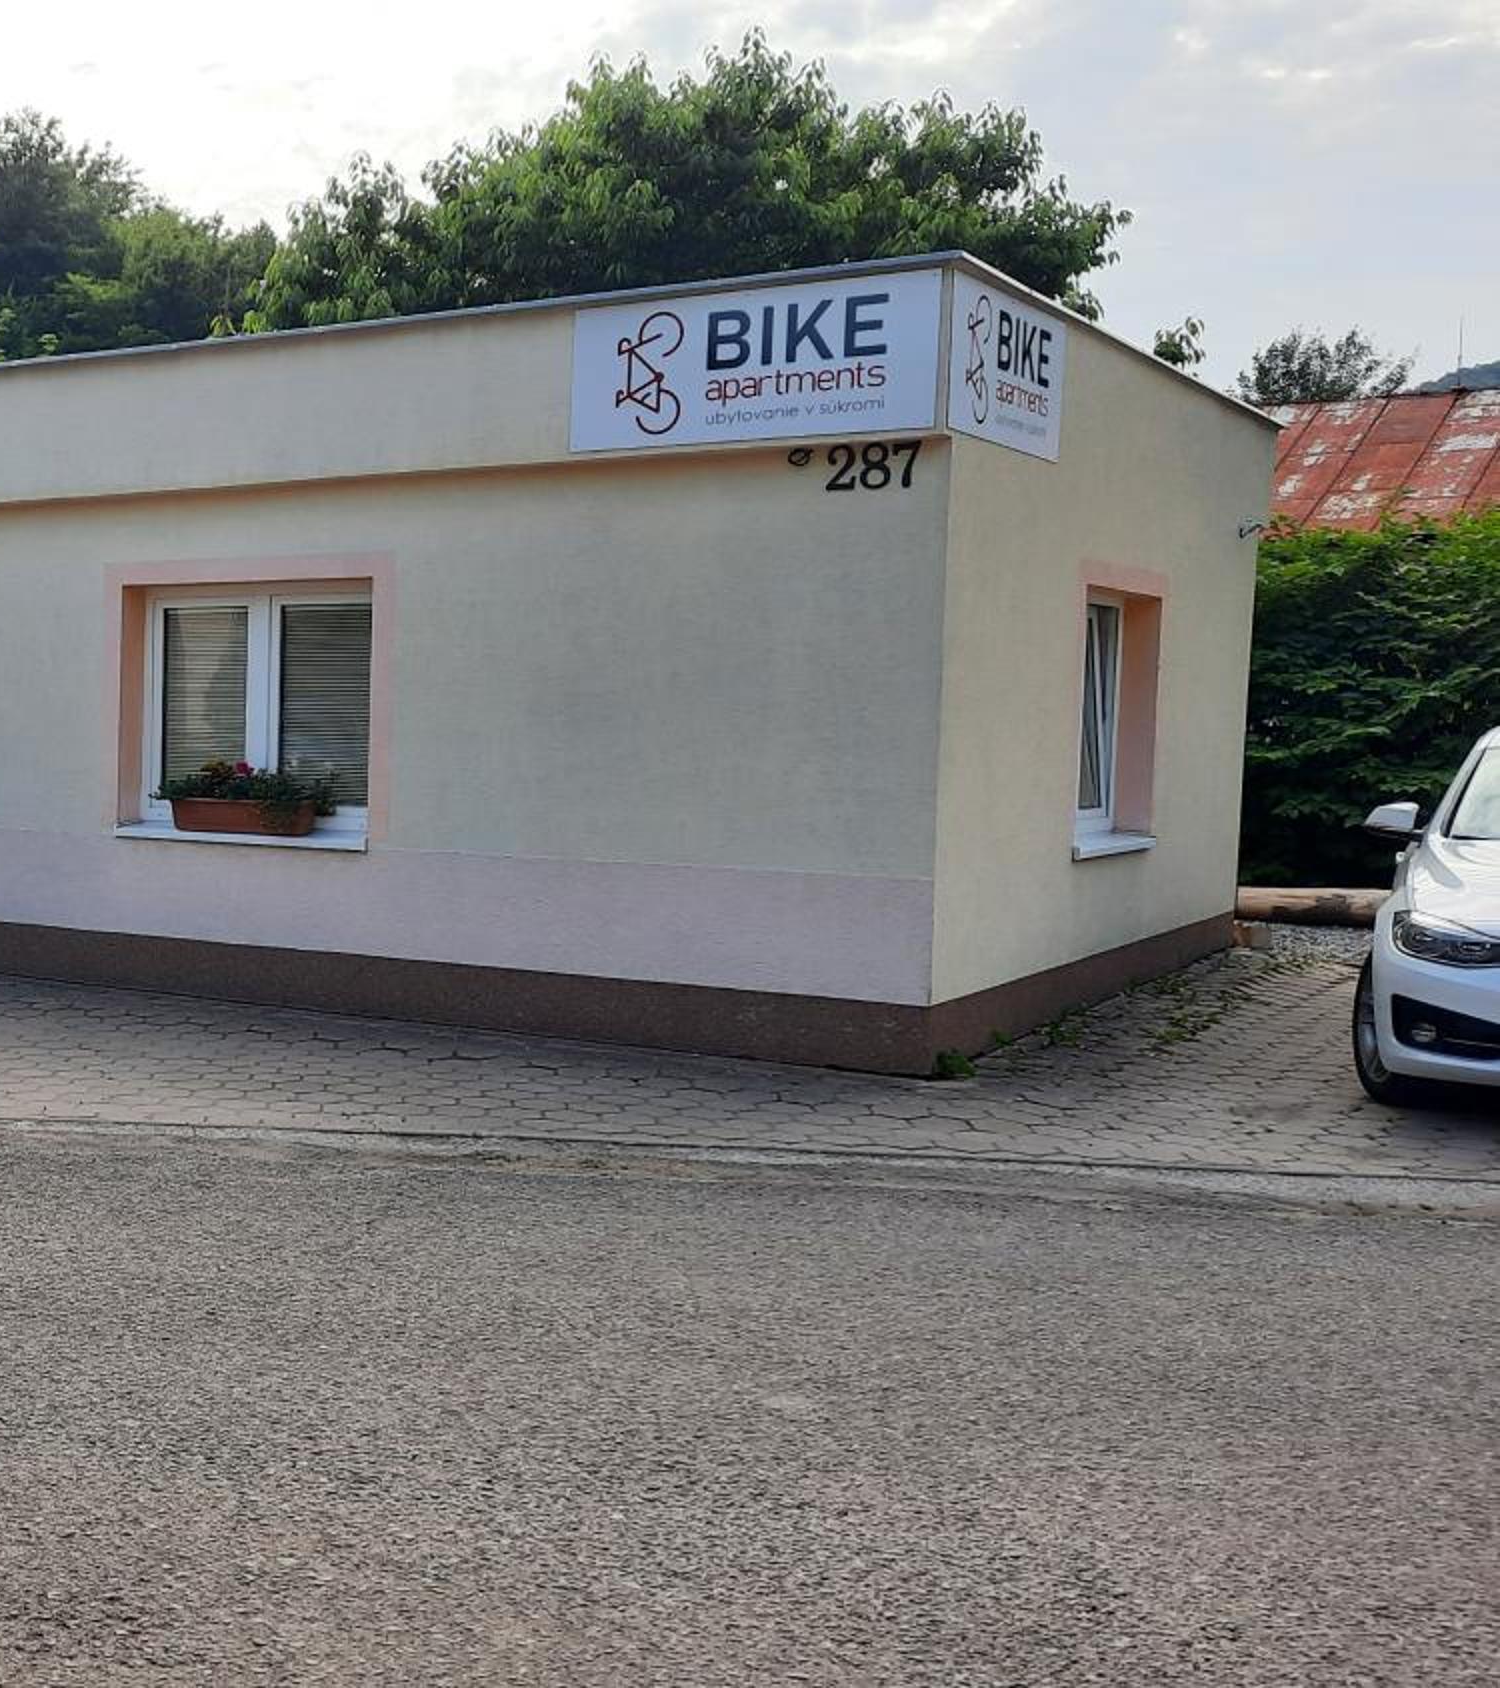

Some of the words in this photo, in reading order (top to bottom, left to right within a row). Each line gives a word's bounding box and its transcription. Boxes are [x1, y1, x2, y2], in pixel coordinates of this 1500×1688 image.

[706, 293, 890, 371] BIKE
[997, 309, 1052, 389] BIKE
[705, 361, 887, 407] apartments
[825, 439, 922, 491] 287
